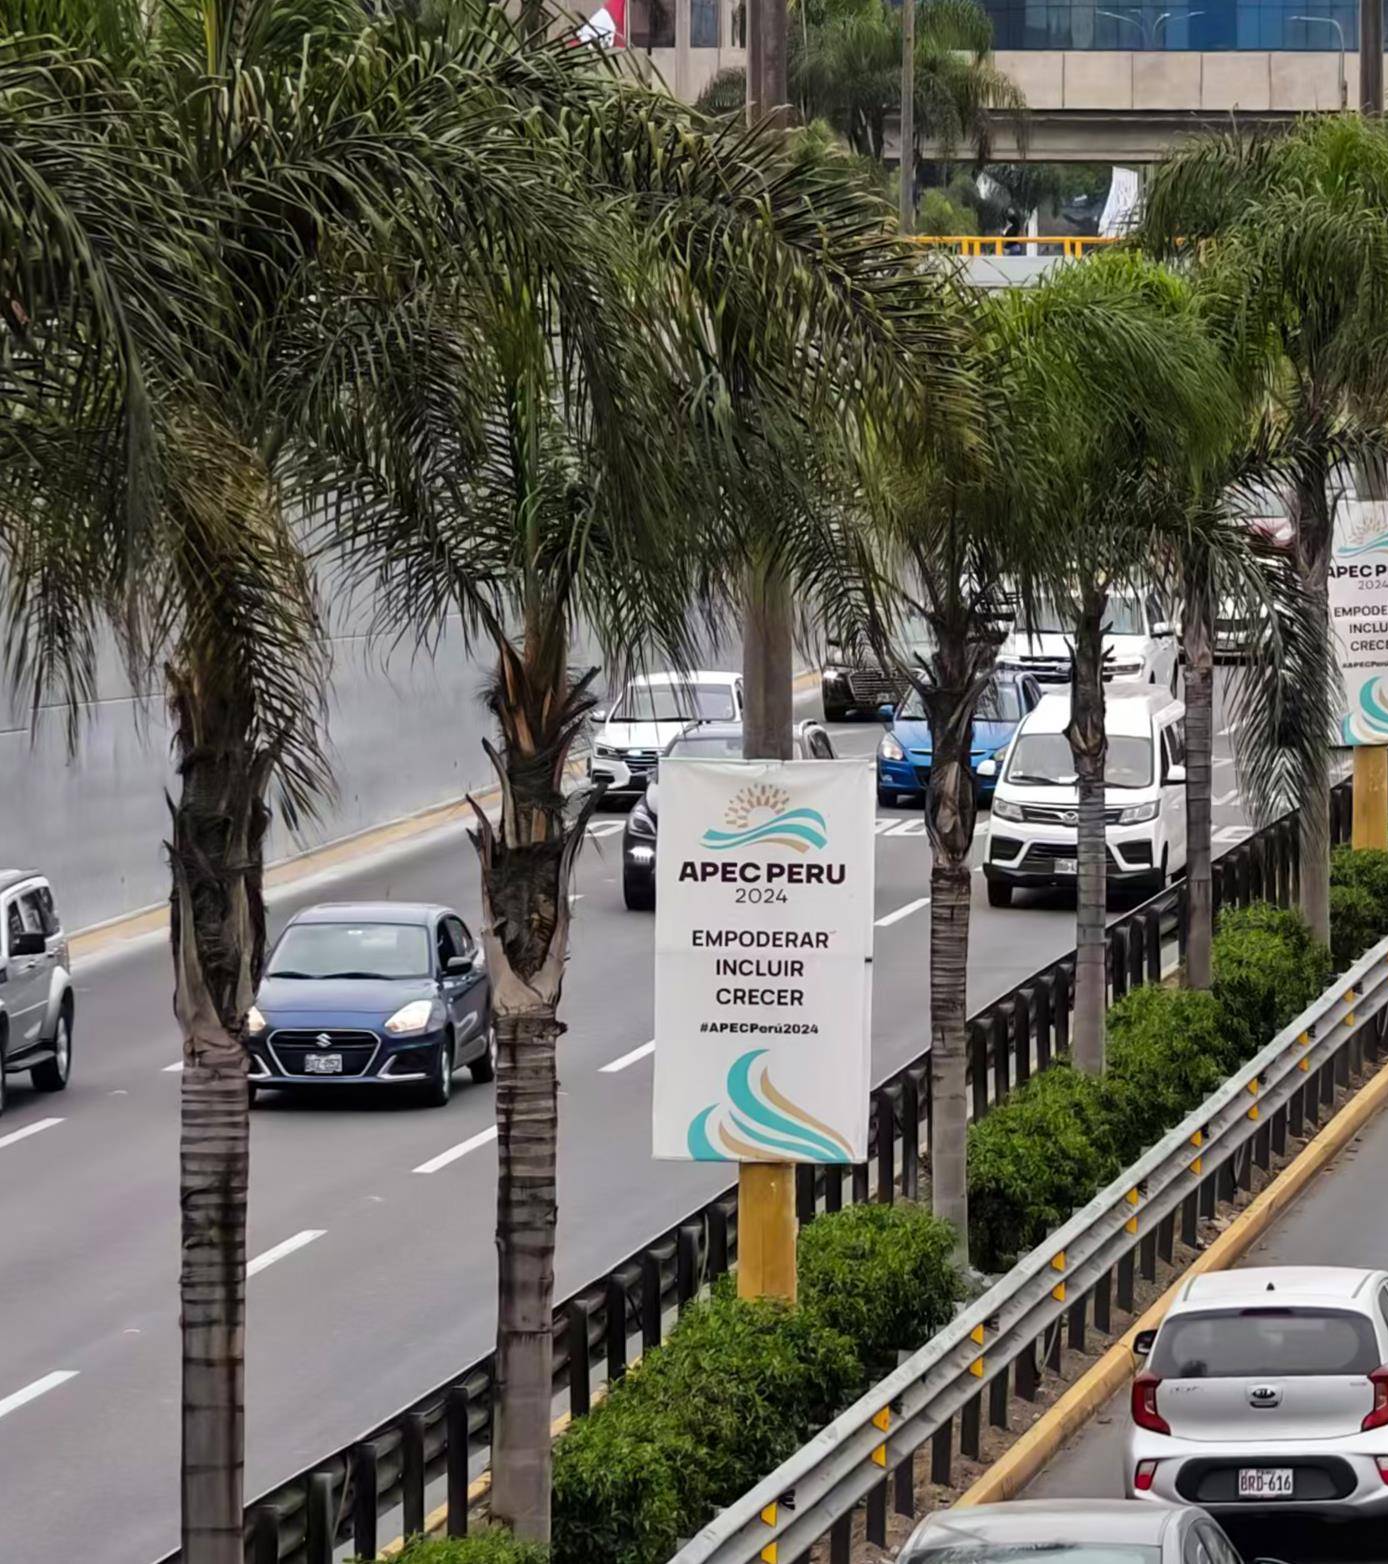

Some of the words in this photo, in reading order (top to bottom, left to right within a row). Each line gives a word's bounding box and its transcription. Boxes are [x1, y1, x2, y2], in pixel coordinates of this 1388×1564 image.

[678, 861, 761, 885] APEC
[766, 861, 846, 885] PERU
[734, 887, 789, 905] 2024
[691, 929, 829, 949] EMPODERAR
[714, 958, 805, 978] INCLUIR
[715, 987, 805, 1007] CRECER
[700, 1021, 819, 1035] #APECPerú2024
[1240, 1474, 1292, 1492] BRD-616
